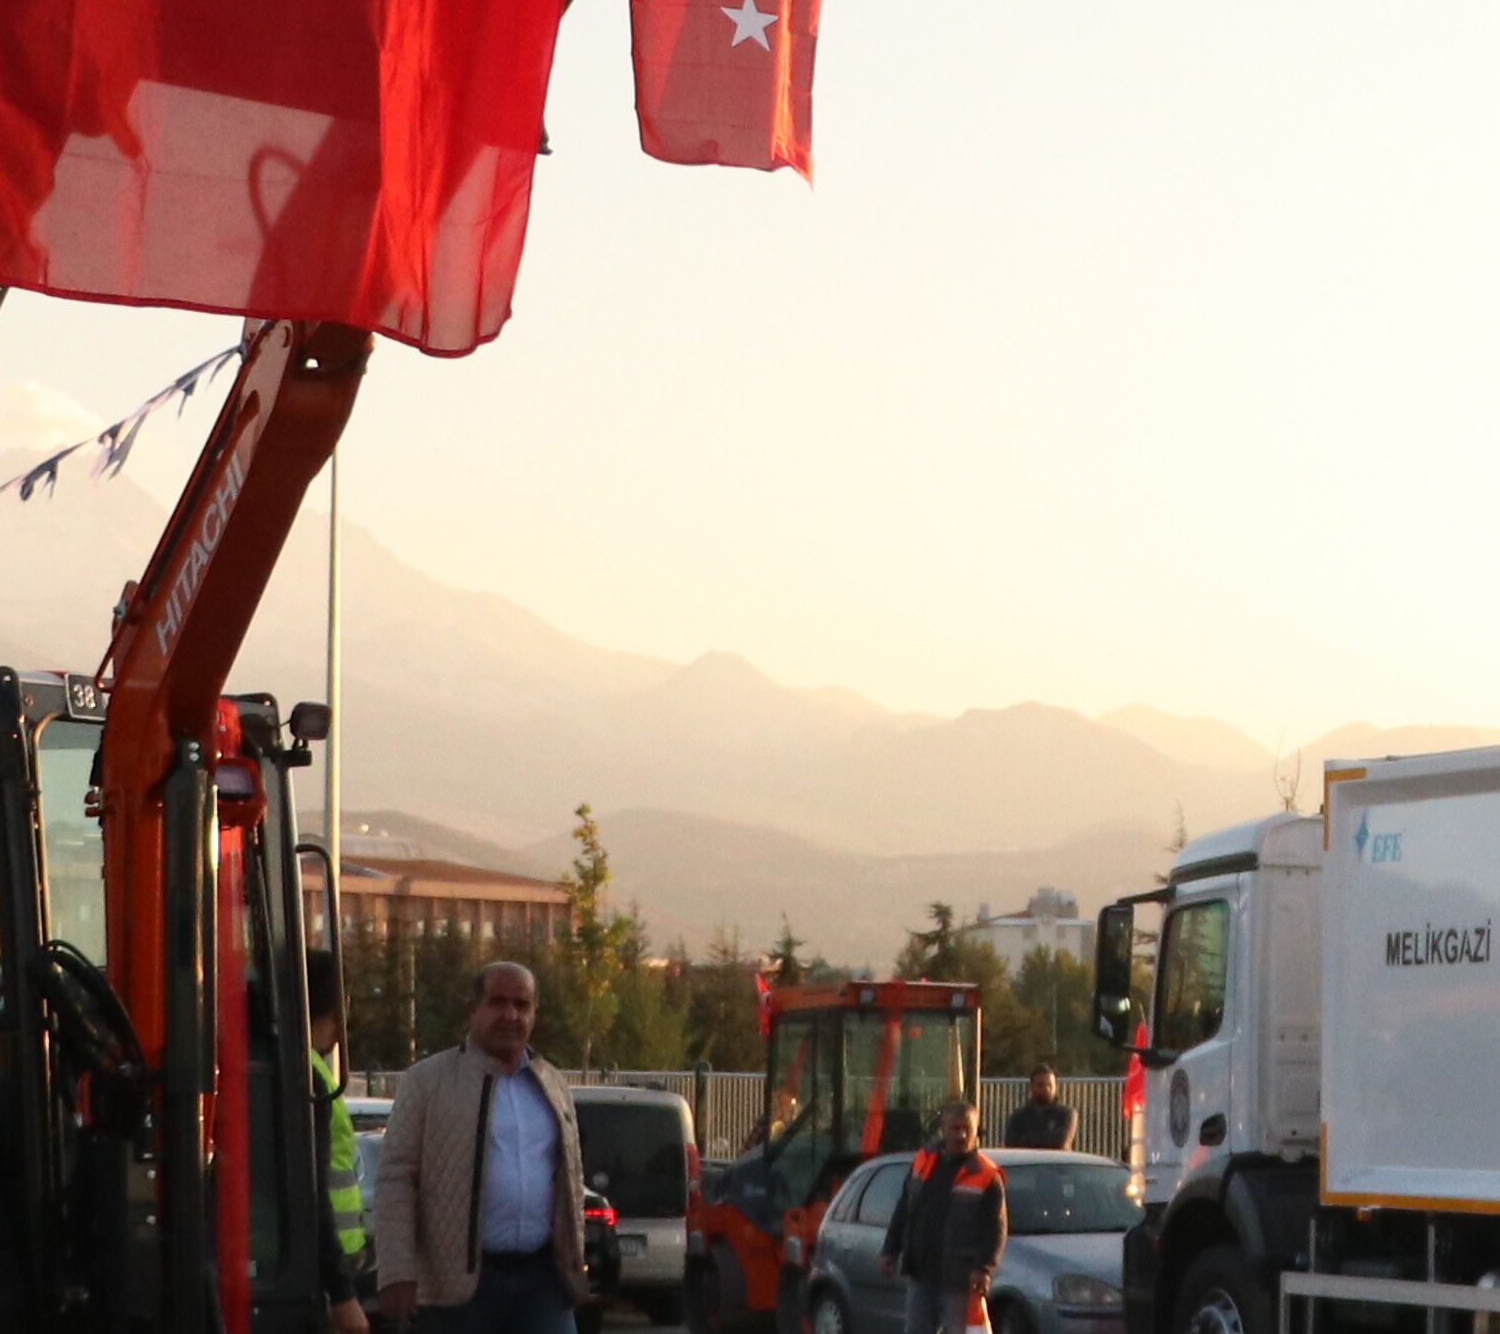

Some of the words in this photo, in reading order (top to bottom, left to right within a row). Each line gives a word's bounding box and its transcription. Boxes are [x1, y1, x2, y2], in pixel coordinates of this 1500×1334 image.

[155, 451, 246, 656] HITACHI
[1372, 832, 1403, 863] EFE
[1386, 918, 1491, 967] MELİKGAZİ
